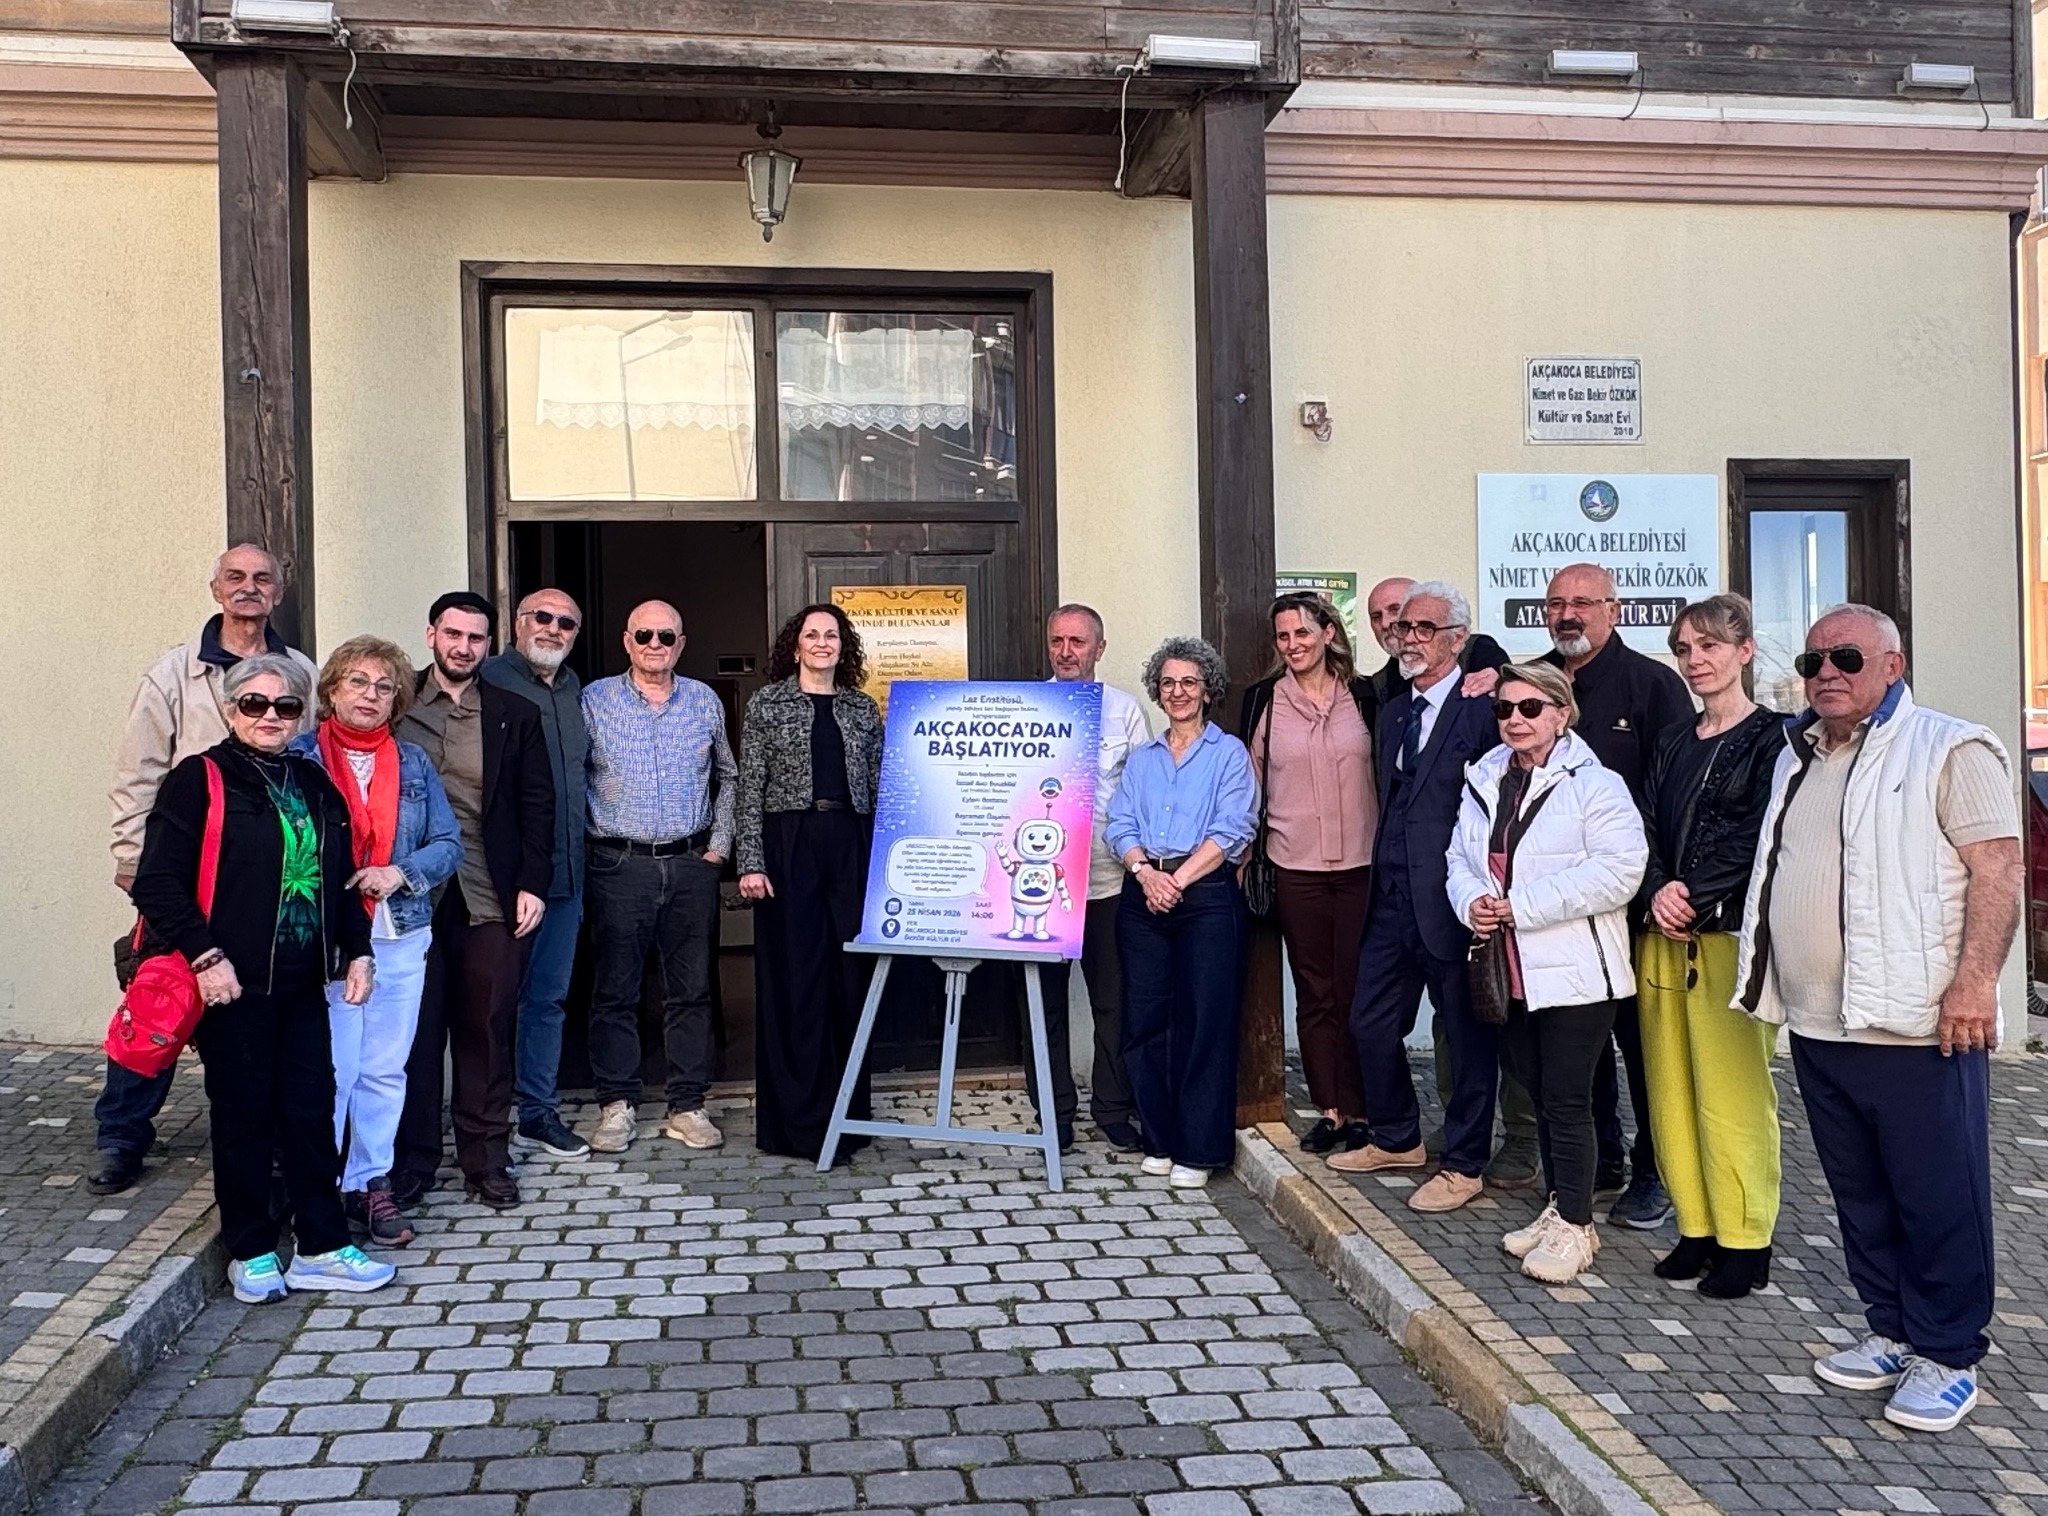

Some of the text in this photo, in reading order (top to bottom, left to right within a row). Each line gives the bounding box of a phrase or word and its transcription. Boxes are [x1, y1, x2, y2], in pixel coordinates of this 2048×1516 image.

[1532, 363, 1636, 381] AKÇAKOCA BELEDİYESİ
[1532, 385, 1637, 401] Nimet ve Gazi Bekir ÖZKÖK
[1538, 410, 1631, 424] Kültür ve Sanat Evi
[1511, 528, 1687, 558] AKÇAKOCA BELEDİYESİ
[1489, 563, 1538, 588] NİMET
[1612, 563, 1651, 588] EKİR
[1655, 562, 1708, 588] ÖZKÖK
[846, 607, 873, 617] ZKÖK
[930, 607, 960, 617] SANAT
[1651, 600, 1677, 625] EVİ
[857, 620, 886, 628] VİNDE
[928, 741, 1056, 761] BAŞLATIYOR.
[906, 908, 917, 916] 25
[917, 907, 942, 917] NİSAN
[971, 911, 994, 919] 14:00
